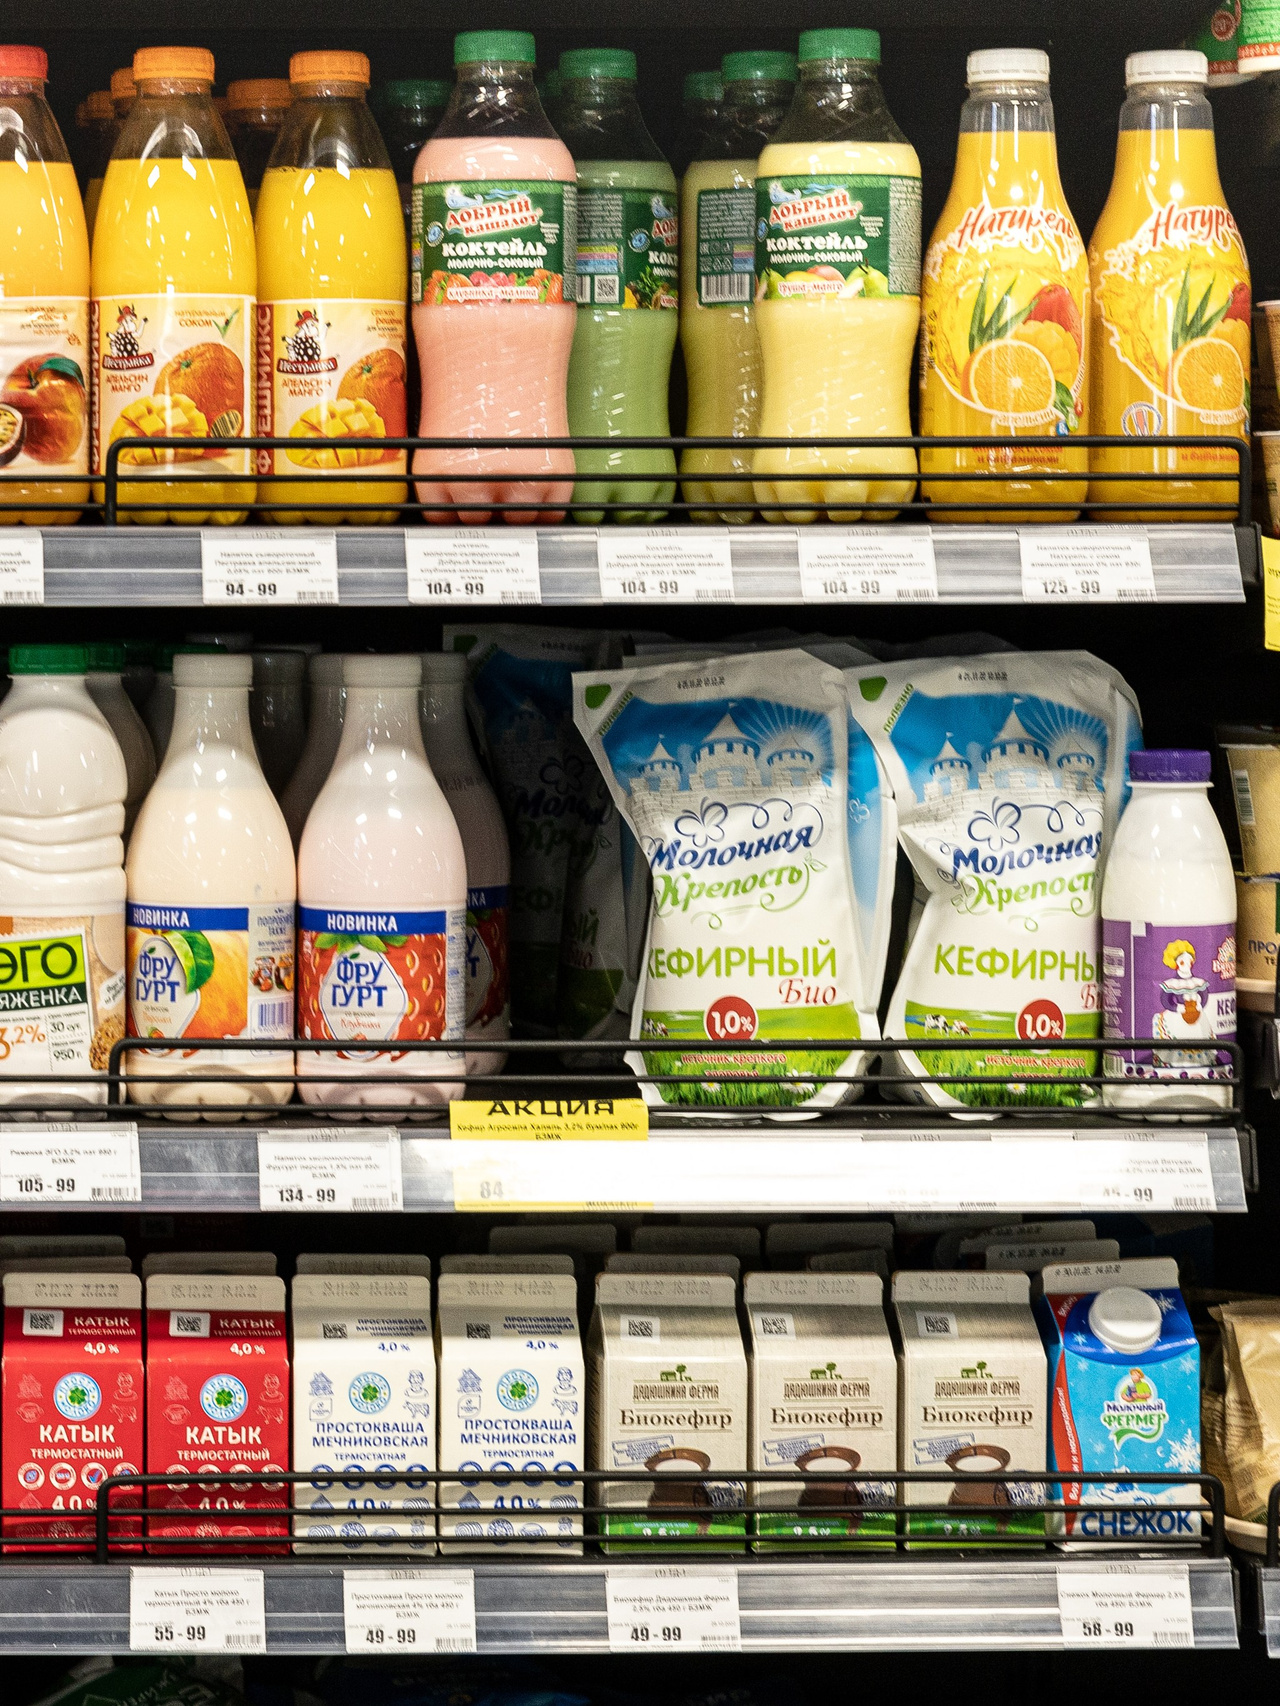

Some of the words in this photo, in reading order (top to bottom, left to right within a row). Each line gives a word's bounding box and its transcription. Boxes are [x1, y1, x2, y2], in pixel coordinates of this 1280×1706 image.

[446, 195, 532, 228] ДОБРЫЙ
[770, 190, 850, 225] ДОБРЫЙ
[957, 205, 1078, 249] Натурель
[178, 318, 212, 328] СОКОМ
[104, 353, 152, 370] Пестравка
[278, 357, 337, 374] Пестравка
[110, 383, 141, 393] МАНГО
[288, 387, 323, 397] МАНГО
[649, 824, 815, 872] Молочная
[952, 831, 1103, 878] Молочная
[653, 862, 804, 912] Крепость
[133, 908, 190, 928] НОВИНКА
[327, 912, 399, 932] НОВИНКА
[647, 939, 837, 979] КЕФИРНЫЙ
[136, 978, 180, 1003] ГУРТ
[331, 984, 388, 1008] ГУРТ
[778, 977, 838, 1007] Био
[49, 1020, 65, 1034] 30
[53, 1049, 75, 1061] 950
[681, 1054, 730, 1064] источник
[732, 1053, 787, 1065] крепкого
[487, 1099, 615, 1118] АКЦИЯ
[73, 1315, 130, 1328] КАТЫК
[219, 1317, 275, 1329] КАТЫК
[688, 1383, 719, 1398] ФЕРМА
[840, 1381, 871, 1397] ФЕРМА
[989, 1379, 1020, 1396] ФЕРМА
[619, 1408, 734, 1430] Биокефир
[770, 1407, 884, 1429] Биокефир
[921, 1406, 1034, 1426] Биокефир
[1103, 1412, 1168, 1428] ФЕРМЕР
[38, 1423, 116, 1444] КАТЫК
[316, 1421, 425, 1434] ПРОСТОКВАША
[464, 1418, 573, 1432] ПРОСТОКВАША
[185, 1425, 262, 1445] КАТЫК
[312, 1434, 429, 1448] МЕЧНИКОВСКАЯ
[460, 1431, 577, 1445] МЕЧНИКОВСКАЯ
[30, 1446, 124, 1460] ТЕРМОСТАТНЫЙ
[176, 1448, 271, 1462] ТЕРМОСТАТНЫЙ
[333, 1452, 407, 1462] ТЕРМОСТАТНАЯ
[481, 1449, 556, 1459] ТЕРМОСТАТНАЯ
[1080, 1510, 1194, 1537] СНЕЖОК
